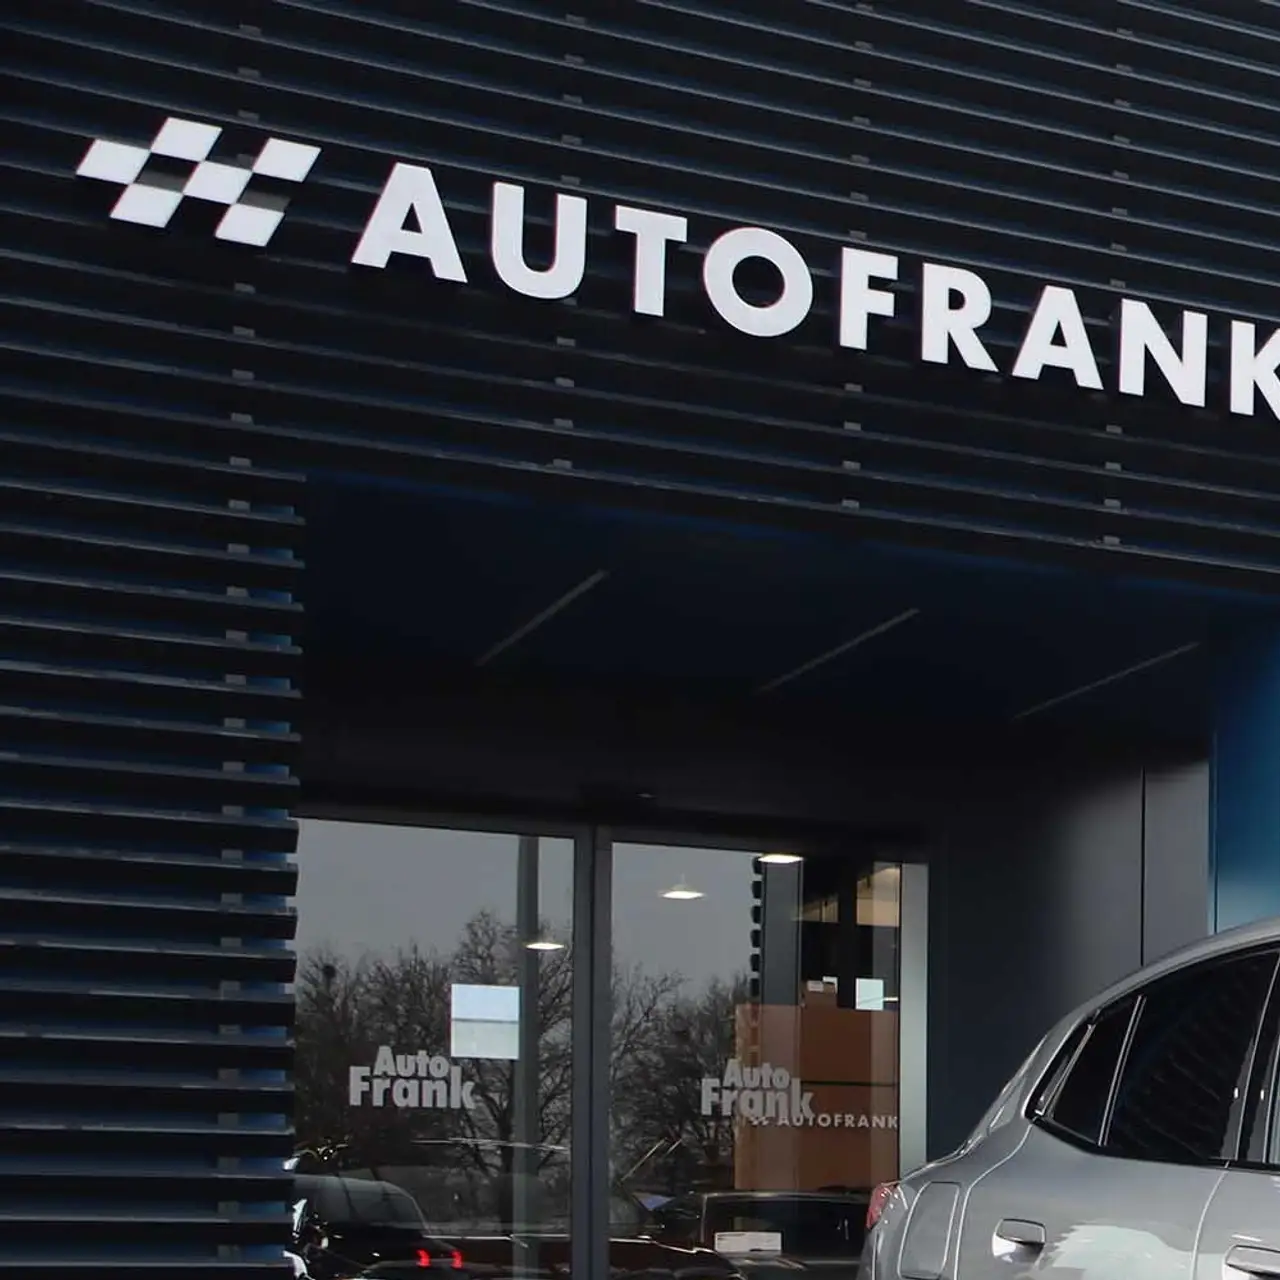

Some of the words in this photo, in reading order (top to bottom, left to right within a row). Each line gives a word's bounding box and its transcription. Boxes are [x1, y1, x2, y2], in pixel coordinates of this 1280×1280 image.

[373, 1045, 449, 1078] Auto
[725, 1059, 789, 1088] Auto
[349, 1066, 477, 1109] Frank
[702, 1077, 815, 1117] Frank
